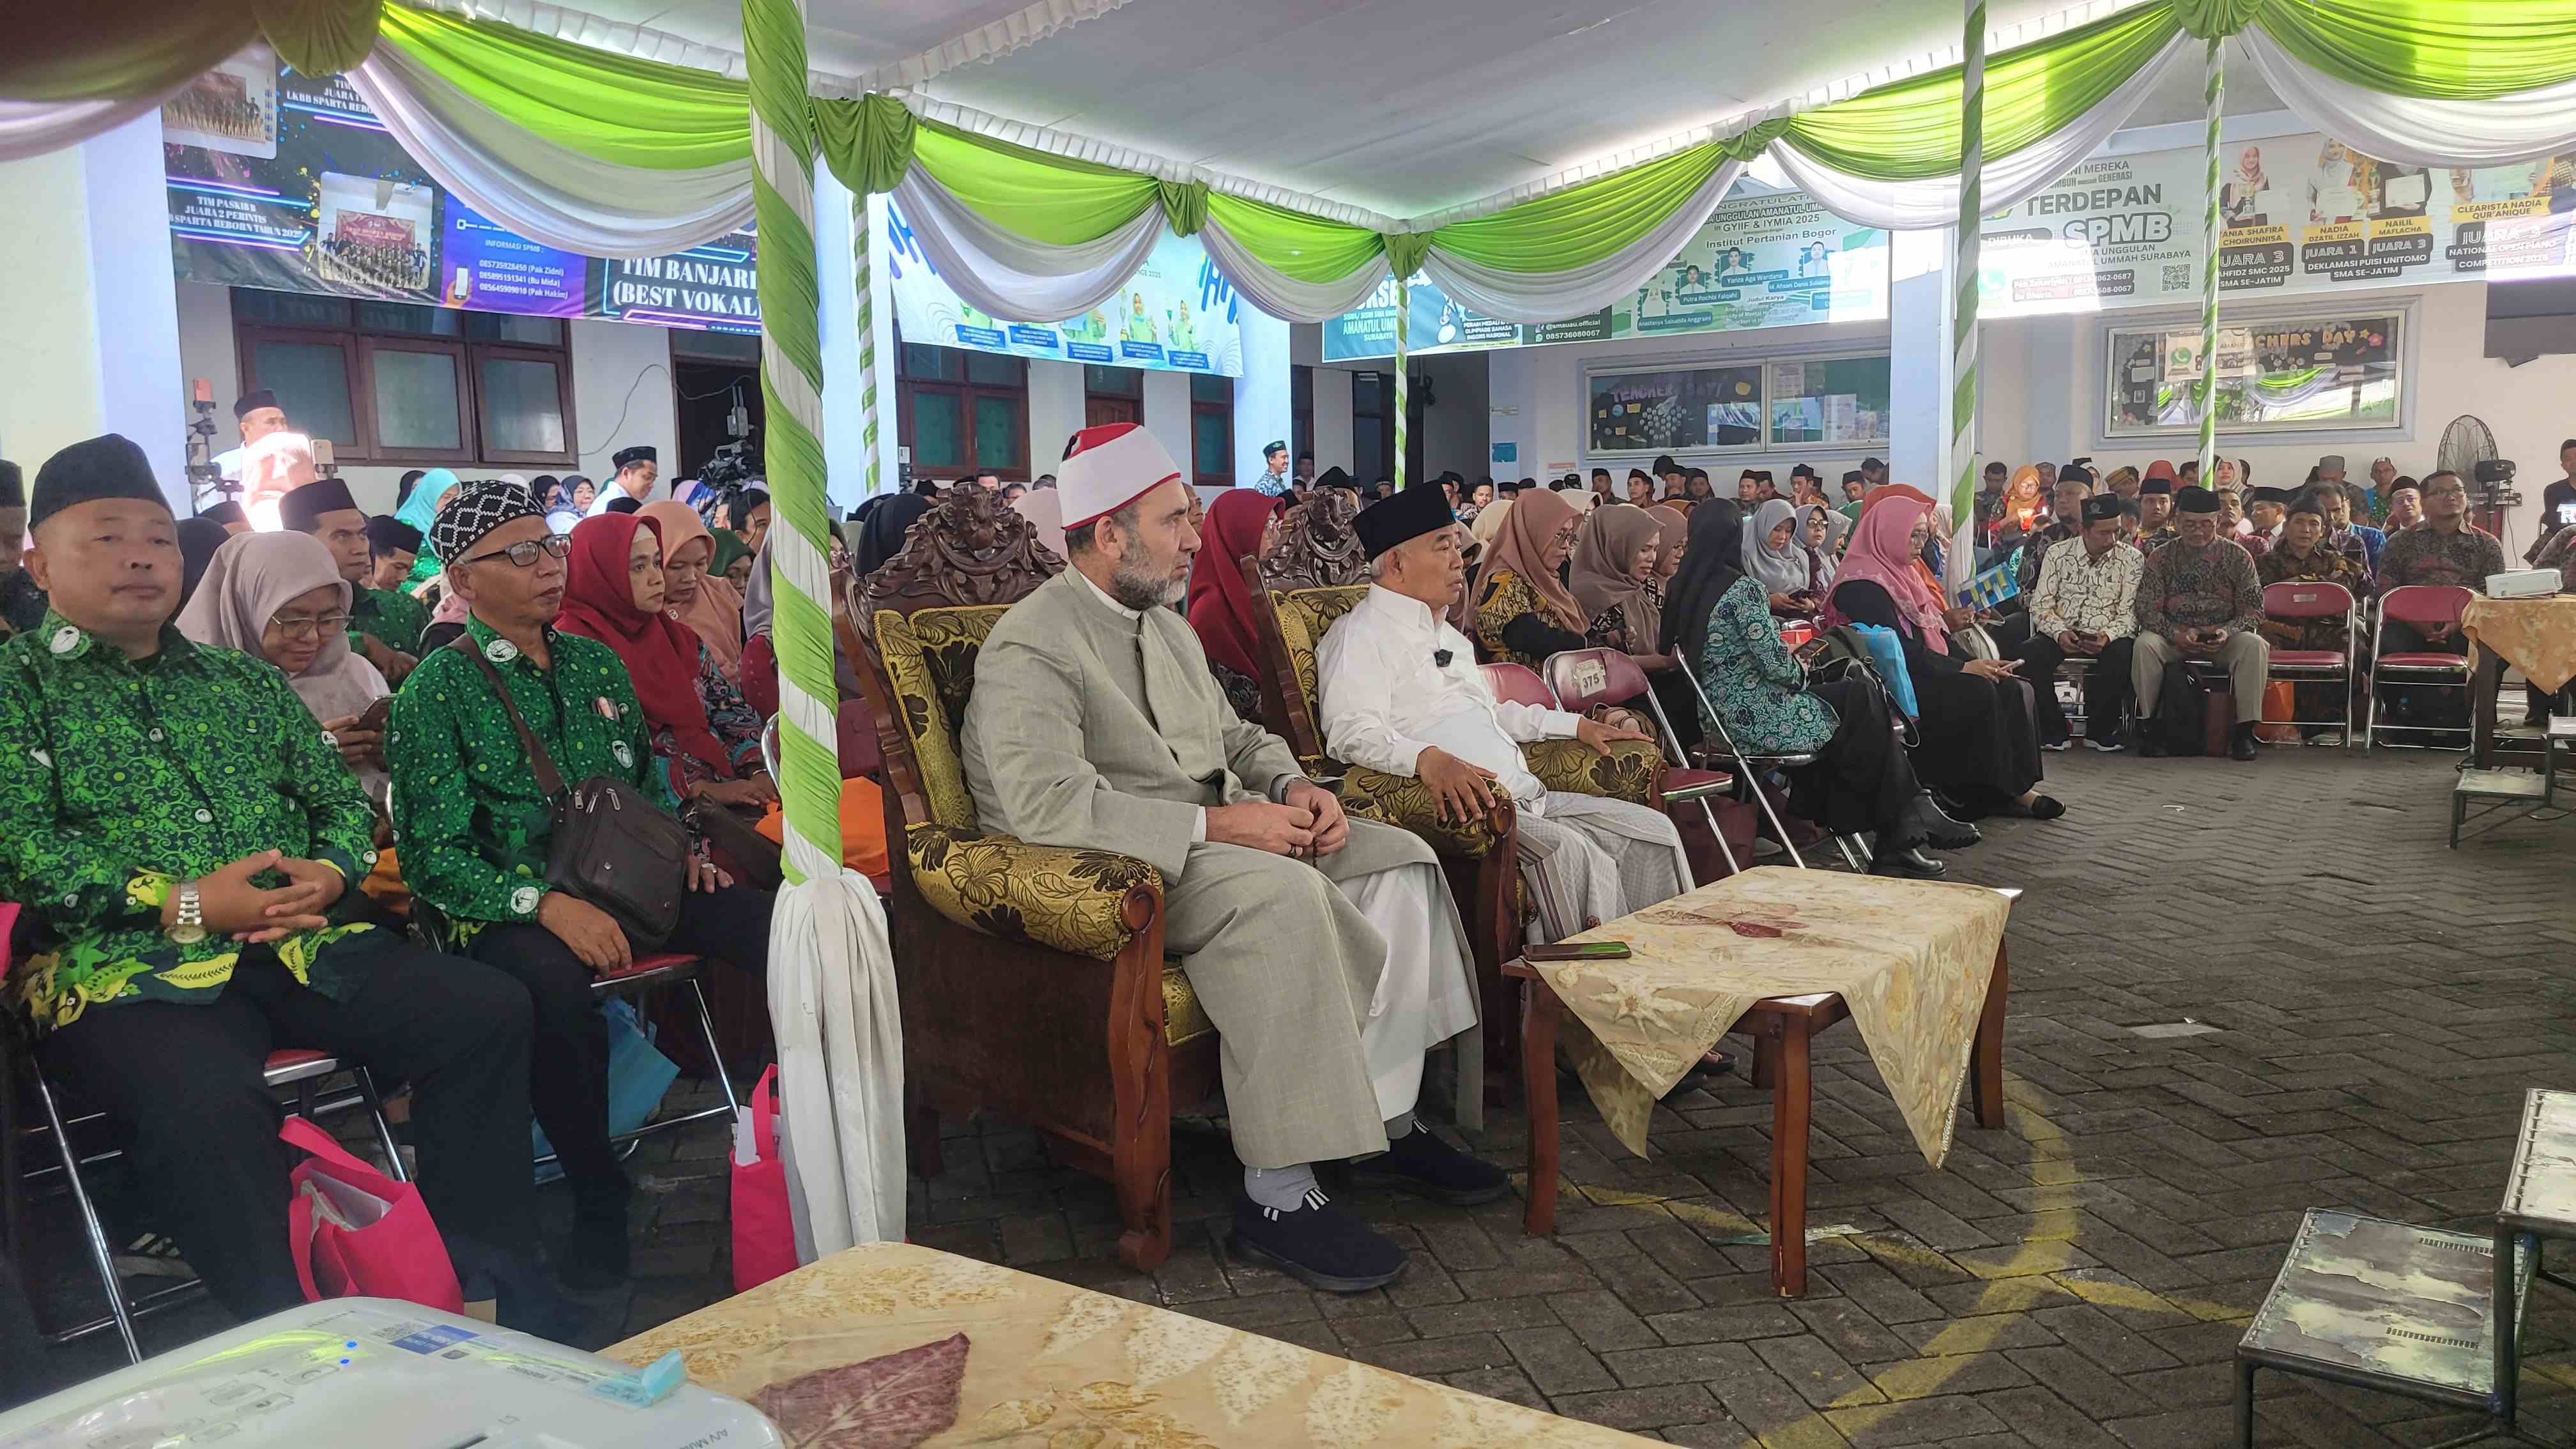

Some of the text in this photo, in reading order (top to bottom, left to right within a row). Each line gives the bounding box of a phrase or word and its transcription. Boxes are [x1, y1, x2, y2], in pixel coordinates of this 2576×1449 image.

[313, 96, 347, 111] SPARTA
[2084, 160, 2129, 174] MEREKA
[2098, 171, 2133, 183] GENERASI
[197, 196, 215, 207] TIM
[2026, 183, 2161, 217] TERDEPAN
[2457, 199, 2542, 214] CLEARISTA NADIA
[185, 205, 267, 224] JUARA 2 PERINTIS
[1715, 210, 1760, 223] UNGGULAN
[1760, 204, 1804, 218] AMANATUL
[2472, 208, 2531, 220] QUR'ANIQUE
[174, 215, 212, 227] SPARTA
[1722, 220, 1749, 233] GYIIF
[1753, 220, 1760, 229] &
[1763, 217, 1793, 227] IYMIA
[1795, 213, 1820, 225] 2025
[2386, 219, 2413, 228] NAILIL
[2064, 212, 2172, 249] SPMB
[2247, 226, 2284, 236] SHAFIRA
[2320, 225, 2349, 234] NADIA
[2379, 227, 2422, 236] MAFLACHA
[1706, 228, 1837, 249] Institut Pertanian Bogor
[2223, 235, 2282, 247] CHOIRUNNISA
[2309, 232, 2359, 242] DZATIL IZZAH
[2101, 244, 2156, 256] UNGGULAN
[2305, 245, 2357, 260] JUARA 1
[2372, 239, 2426, 254] JUARA 3
[2449, 244, 2497, 257] NATIONAL
[2101, 254, 2138, 264] UMMAH
[2140, 250, 2191, 261] SURABAYA
[2273, 250, 2285, 263] 3
[2308, 254, 2426, 272] DEKLAMASI PUISI UNITOMO
[2458, 257, 2524, 268] COMPETITION
[621, 257, 661, 279] TIM
[2269, 264, 2290, 274] 2025
[2333, 266, 2399, 279] SMA SE-JATIM
[2240, 276, 2281, 286] SE-JATIM
[613, 280, 677, 308] (BEST
[1343, 318, 1380, 335] AMANATUL
[1546, 330, 1600, 340] 085736080067
[1583, 673, 1600, 688] 375
[1942, 1102, 1956, 1151] UNGGULAN
